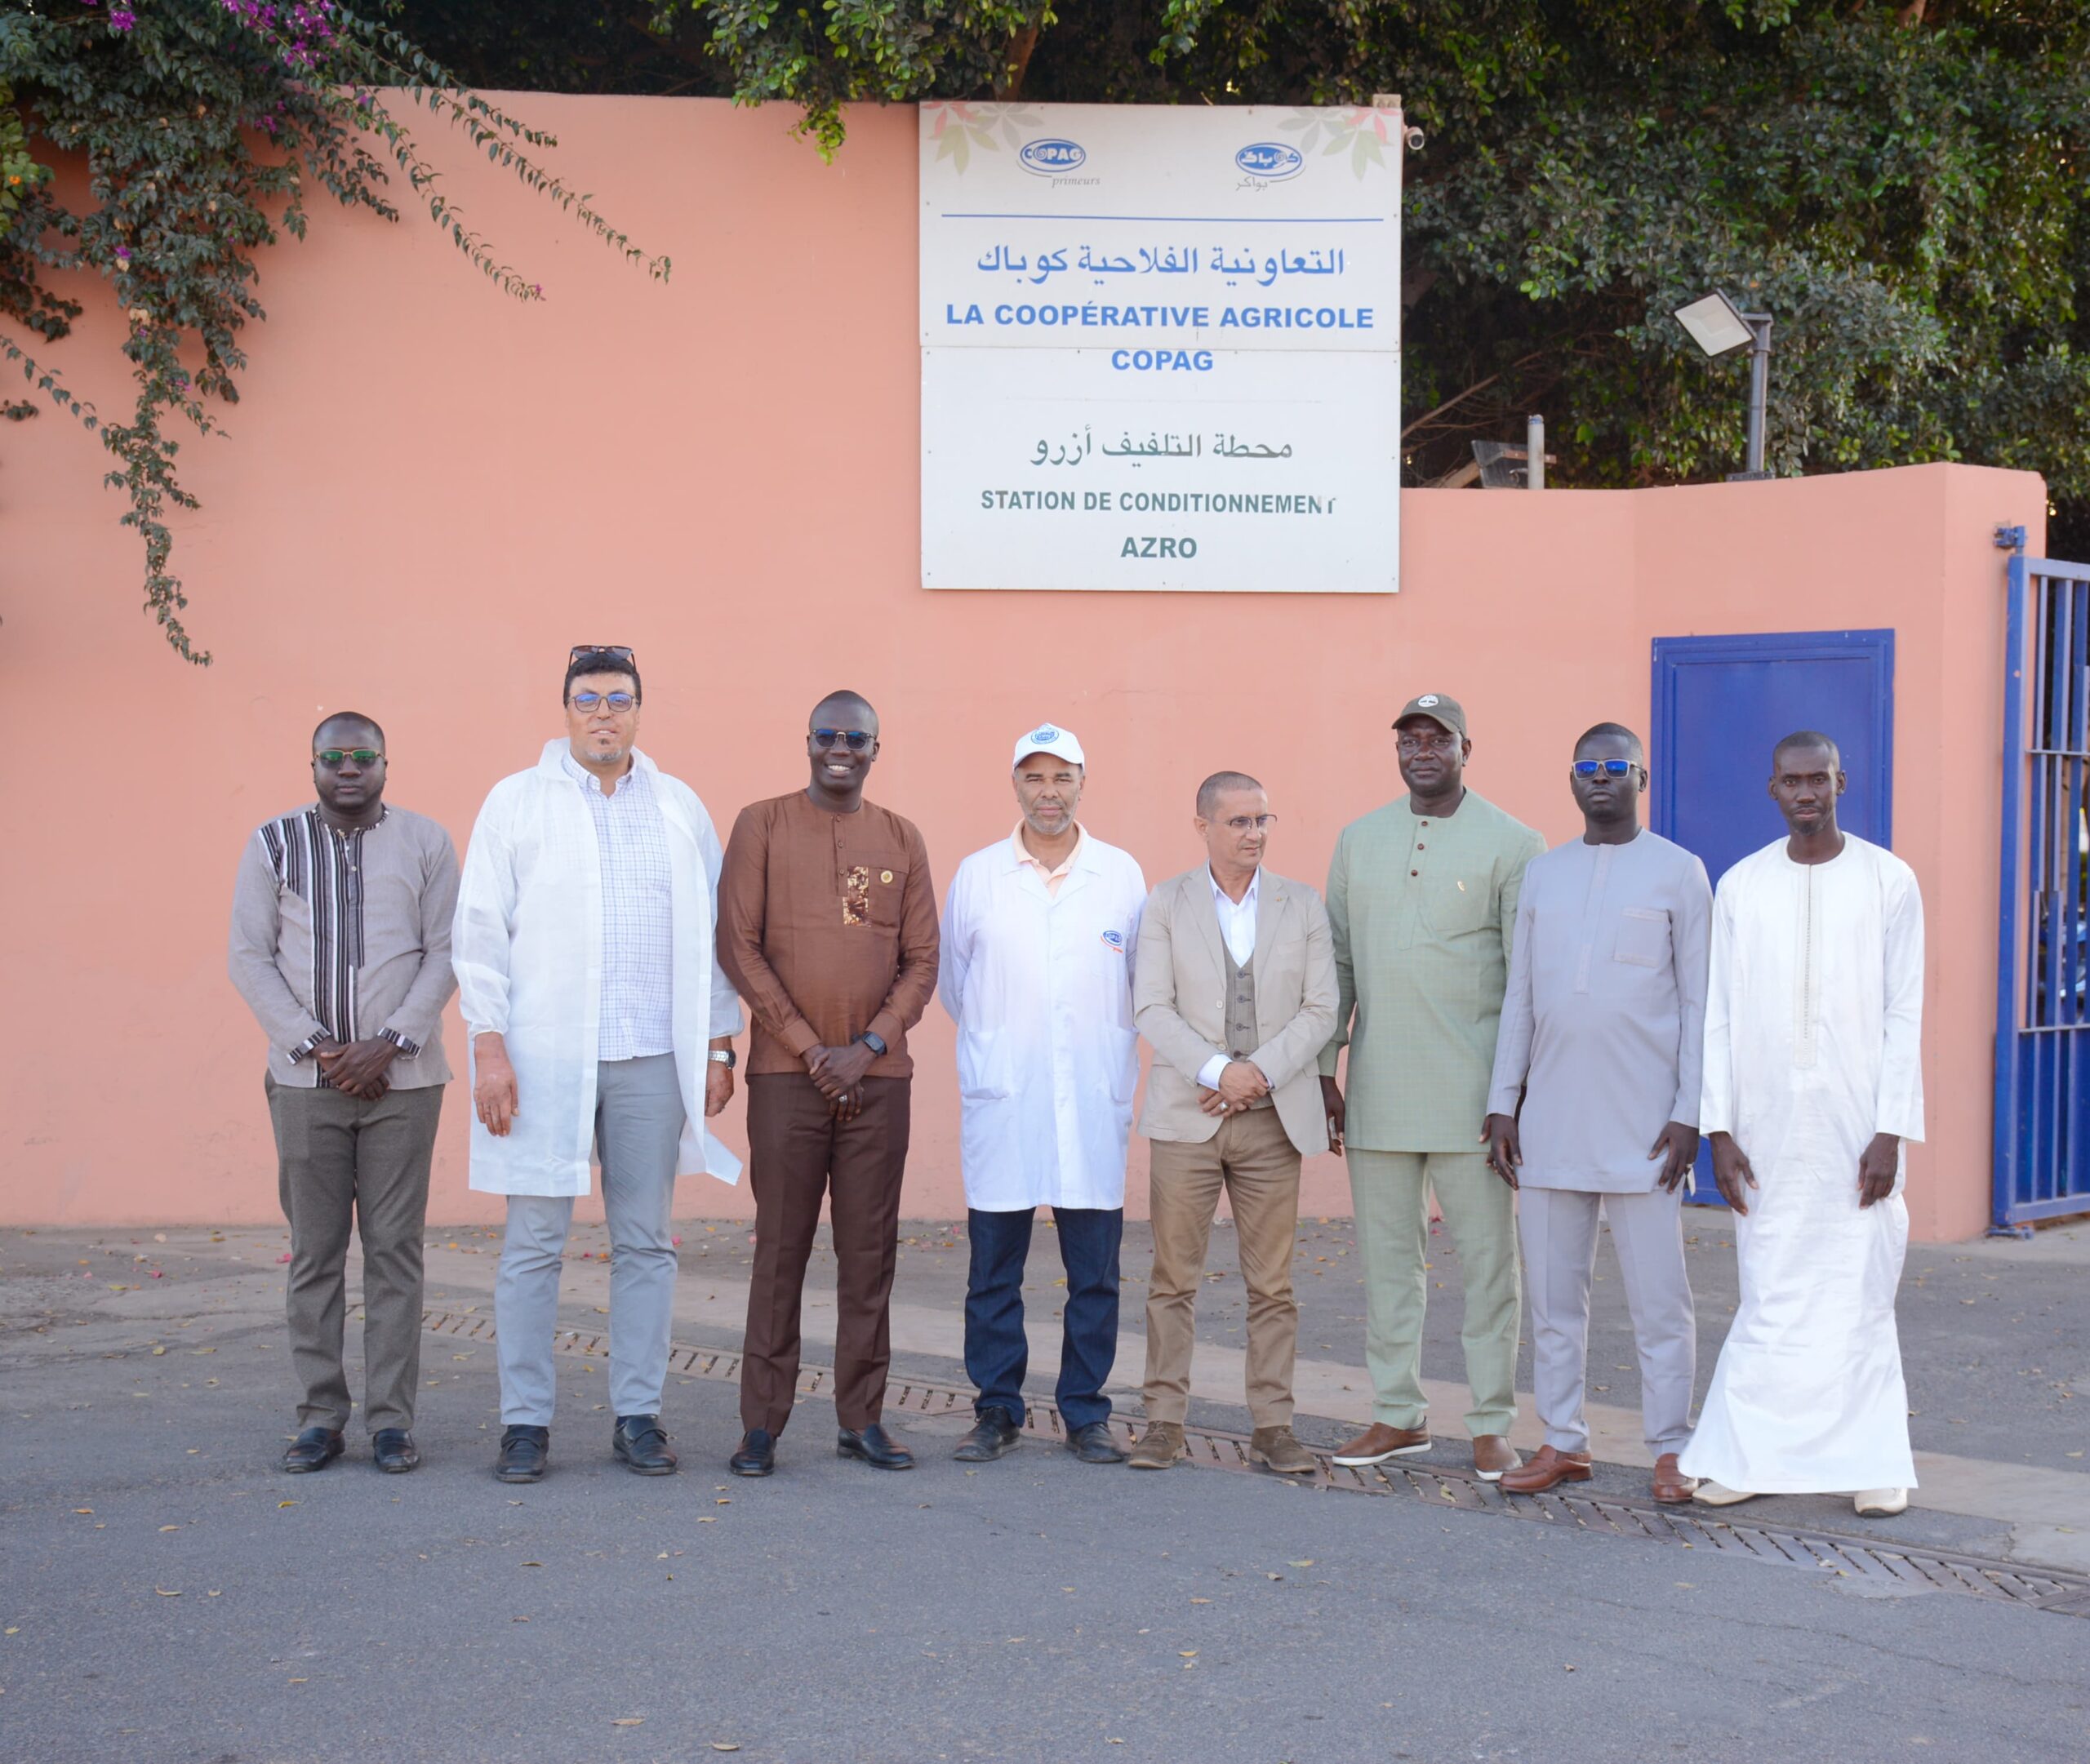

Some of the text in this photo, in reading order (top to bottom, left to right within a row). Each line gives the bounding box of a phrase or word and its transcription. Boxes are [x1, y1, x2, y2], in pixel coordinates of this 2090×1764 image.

[1024, 148, 1083, 161] COPAG
[1050, 177, 1101, 189] primeurs
[977, 245, 1345, 287] التعاونية الفلاحية كوباك
[947, 300, 1374, 329] LA COOPÉRATIVE AGRICOLE
[1111, 349, 1213, 371] COPAG
[1029, 424, 1293, 468] محطة التلفيف أزرو
[981, 490, 1075, 510] STATION
[1084, 491, 1112, 511] DE
[1120, 536, 1198, 558] AZRO
